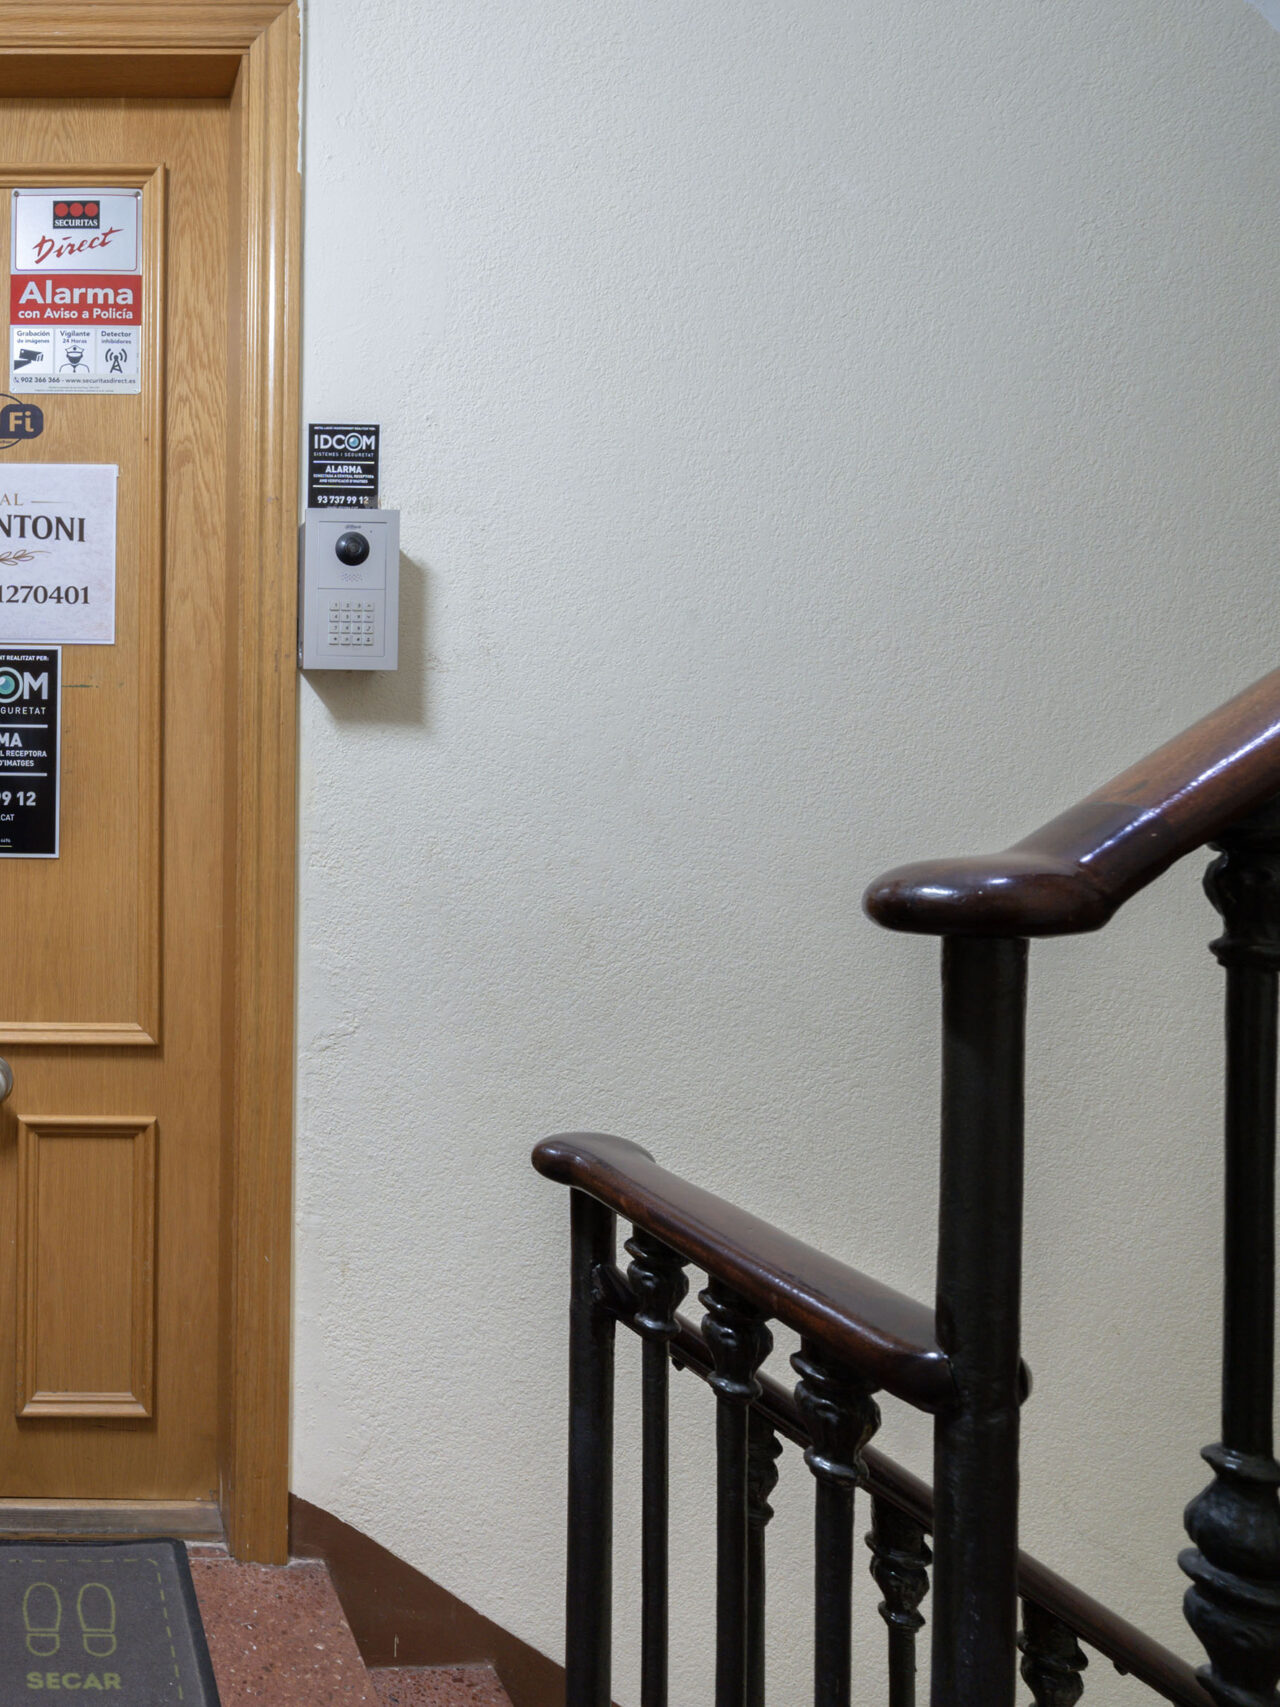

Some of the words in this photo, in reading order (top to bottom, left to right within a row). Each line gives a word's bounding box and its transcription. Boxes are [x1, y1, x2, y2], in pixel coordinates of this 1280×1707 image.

[54, 219, 98, 227] SECURITAS
[32, 227, 124, 264] Direct
[18, 279, 133, 305] Alarma
[18, 310, 40, 319] con
[44, 308, 78, 319] Aviso
[82, 311, 89, 319] a
[93, 308, 133, 319] Policía
[60, 330, 90, 338] Vigilante
[314, 432, 375, 451] IDCOM
[325, 465, 362, 473] ALARMA
[329, 496, 345, 504] 737
[347, 496, 357, 504] 99
[359, 496, 369, 504] 12
[16, 791, 36, 806] 12
[27, 1672, 122, 1690] SECAR
